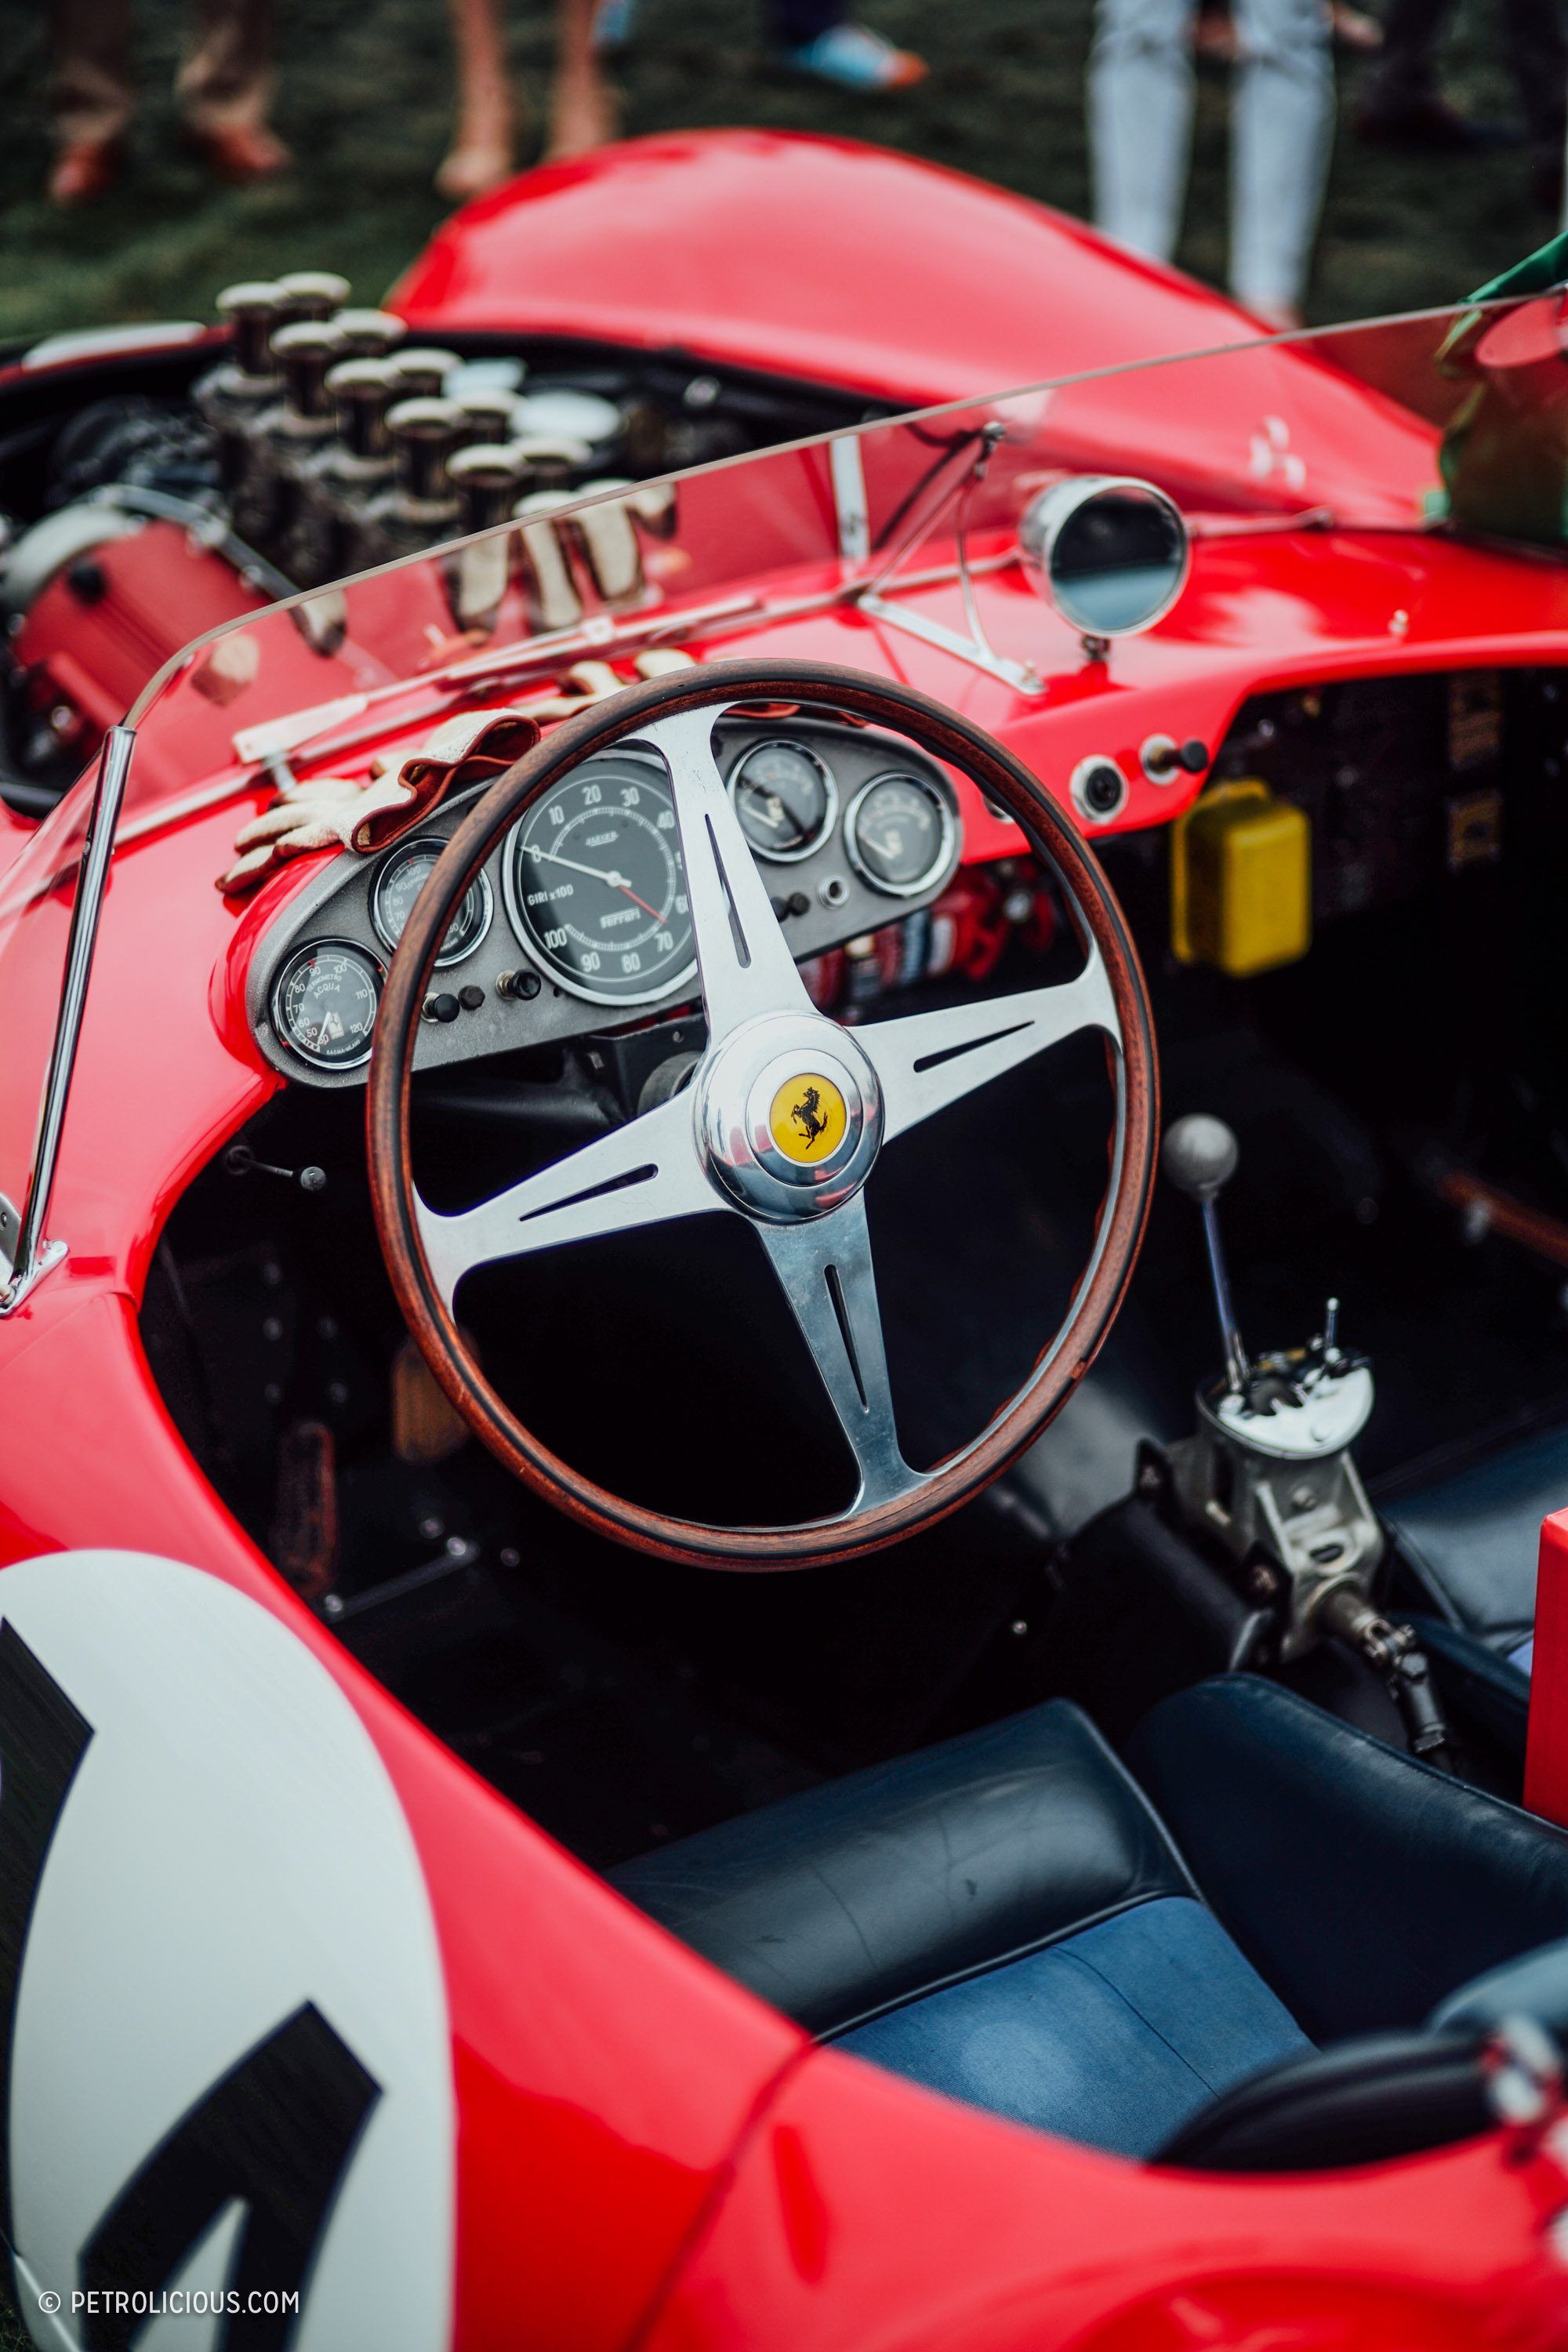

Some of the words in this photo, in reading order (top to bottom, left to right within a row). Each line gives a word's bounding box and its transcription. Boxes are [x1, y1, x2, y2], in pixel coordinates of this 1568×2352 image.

[582, 784, 602, 805] 20
[620, 786, 641, 807] 30
[549, 804, 564, 826] 10
[656, 809, 675, 829] 40
[396, 882, 407, 892] 90
[527, 891, 549, 906] GIRI
[394, 910, 405, 920] 70
[543, 927, 568, 949] 100
[654, 931, 674, 953] 70
[580, 951, 601, 972] 90
[621, 952, 641, 973] 80
[309, 966, 321, 977] 90
[334, 964, 347, 974] 100
[294, 983, 306, 993] 80
[314, 982, 340, 999] ACQUA
[356, 989, 368, 1000] 110
[292, 1003, 305, 1014] 70
[298, 1017, 310, 1028] 60
[350, 1022, 363, 1034] 120
[306, 1027, 318, 1038] 50
